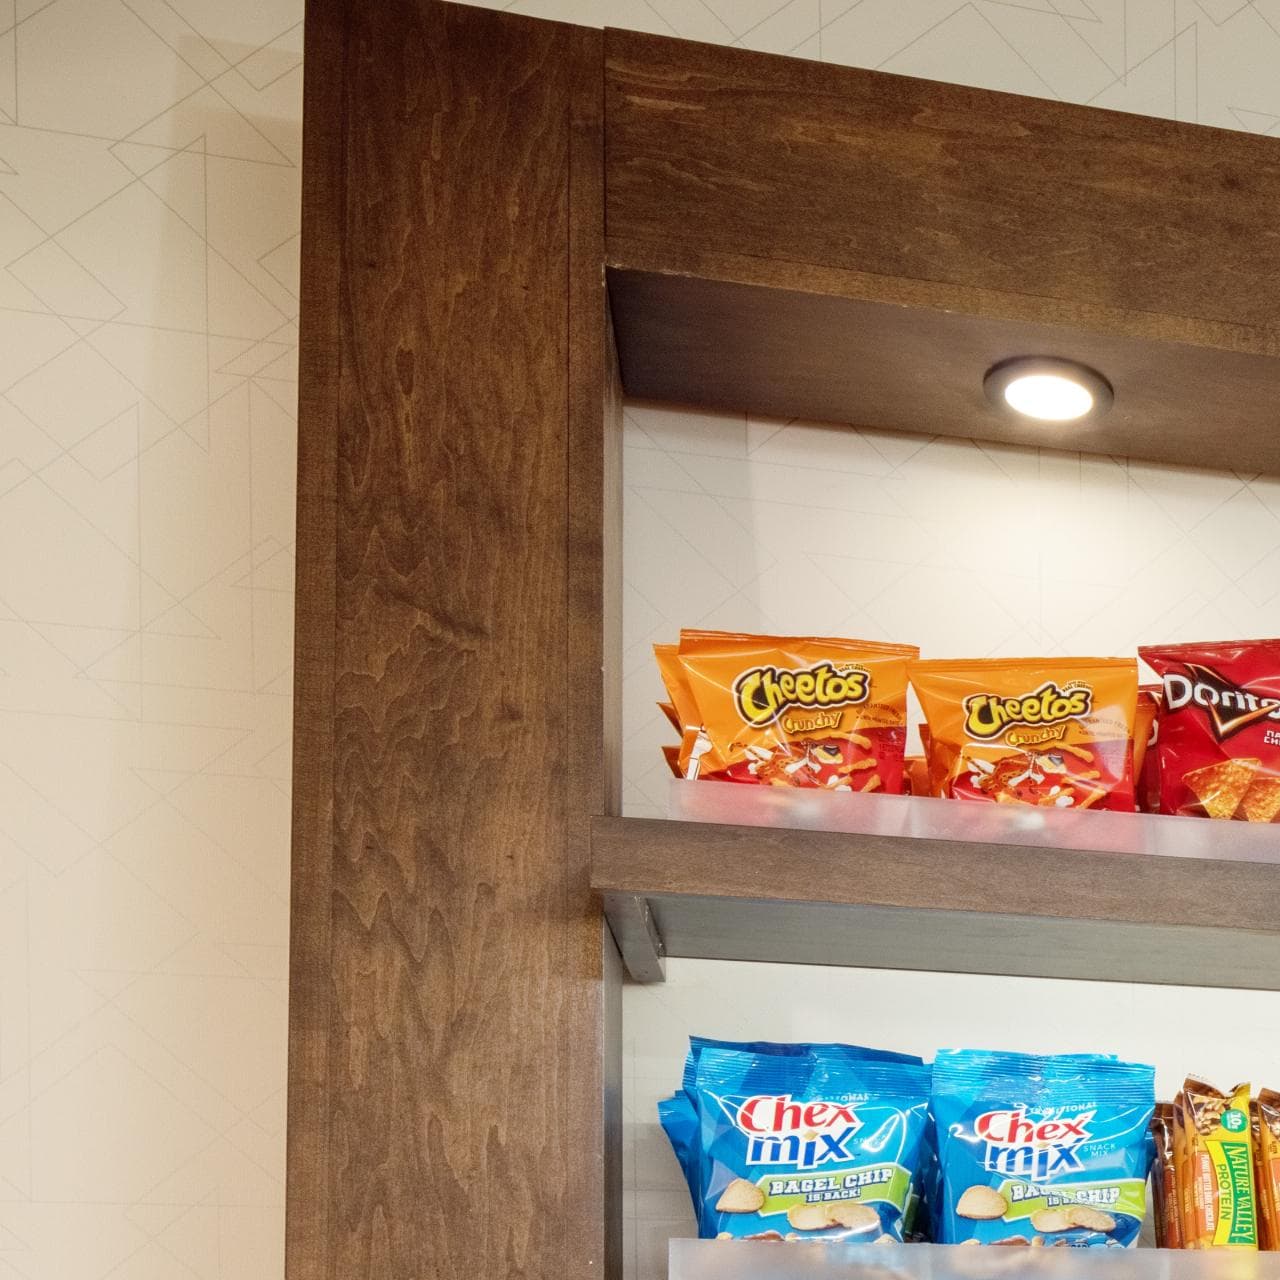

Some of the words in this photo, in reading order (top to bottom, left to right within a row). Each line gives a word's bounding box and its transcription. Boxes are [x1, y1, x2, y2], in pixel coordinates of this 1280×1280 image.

[738, 663, 867, 724] Cheetos
[782, 711, 842, 733] Crunchy
[966, 684, 1089, 739] Cheetos
[1006, 725, 1066, 746] Crunchy
[739, 1096, 861, 1132] Chex
[977, 1110, 1092, 1143] Chex
[1082, 1143, 1117, 1152] SNACK
[769, 1177, 840, 1197] BAGEL
[844, 1168, 893, 1190] CHIP
[1224, 1143, 1250, 1194] NATURE
[823, 1188, 861, 1201] BACK!
[1216, 1163, 1232, 1221] PROTEIN
[1231, 1195, 1254, 1242] VALLEY
